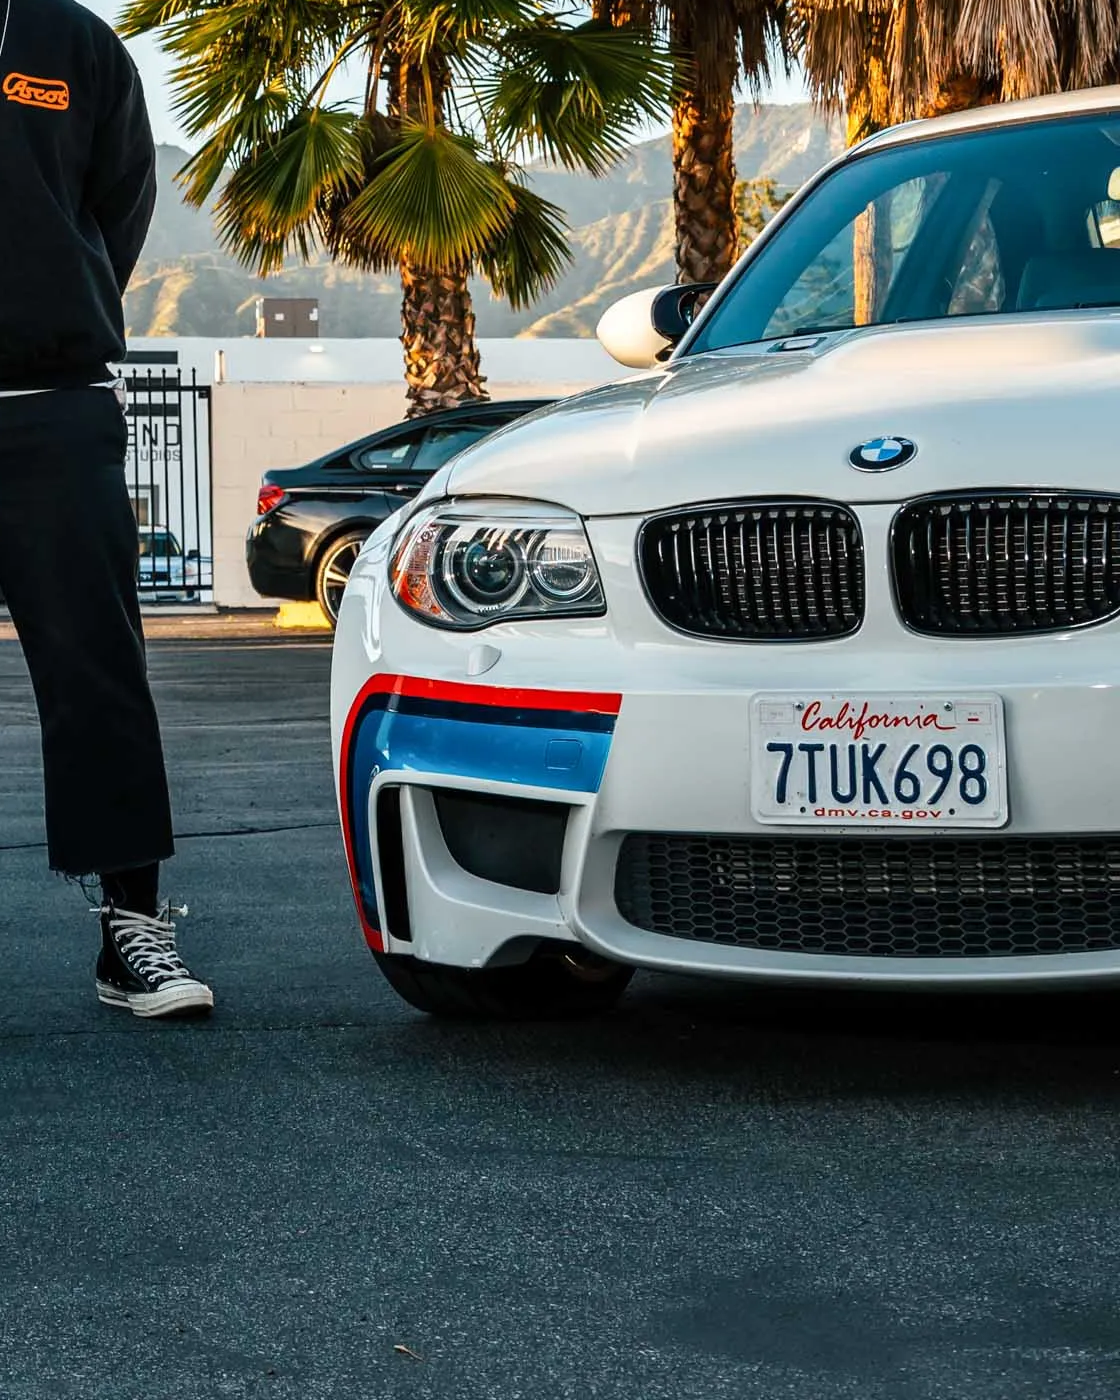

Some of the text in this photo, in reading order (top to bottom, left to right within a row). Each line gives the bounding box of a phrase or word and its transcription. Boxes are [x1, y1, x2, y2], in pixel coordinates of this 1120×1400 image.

[4, 73, 68, 109] Ascot
[125, 449, 181, 462] SUDIOS
[801, 701, 957, 740] California
[766, 743, 987, 805] 7TUK698
[814, 807, 942, 819] dmv.ca.gov
